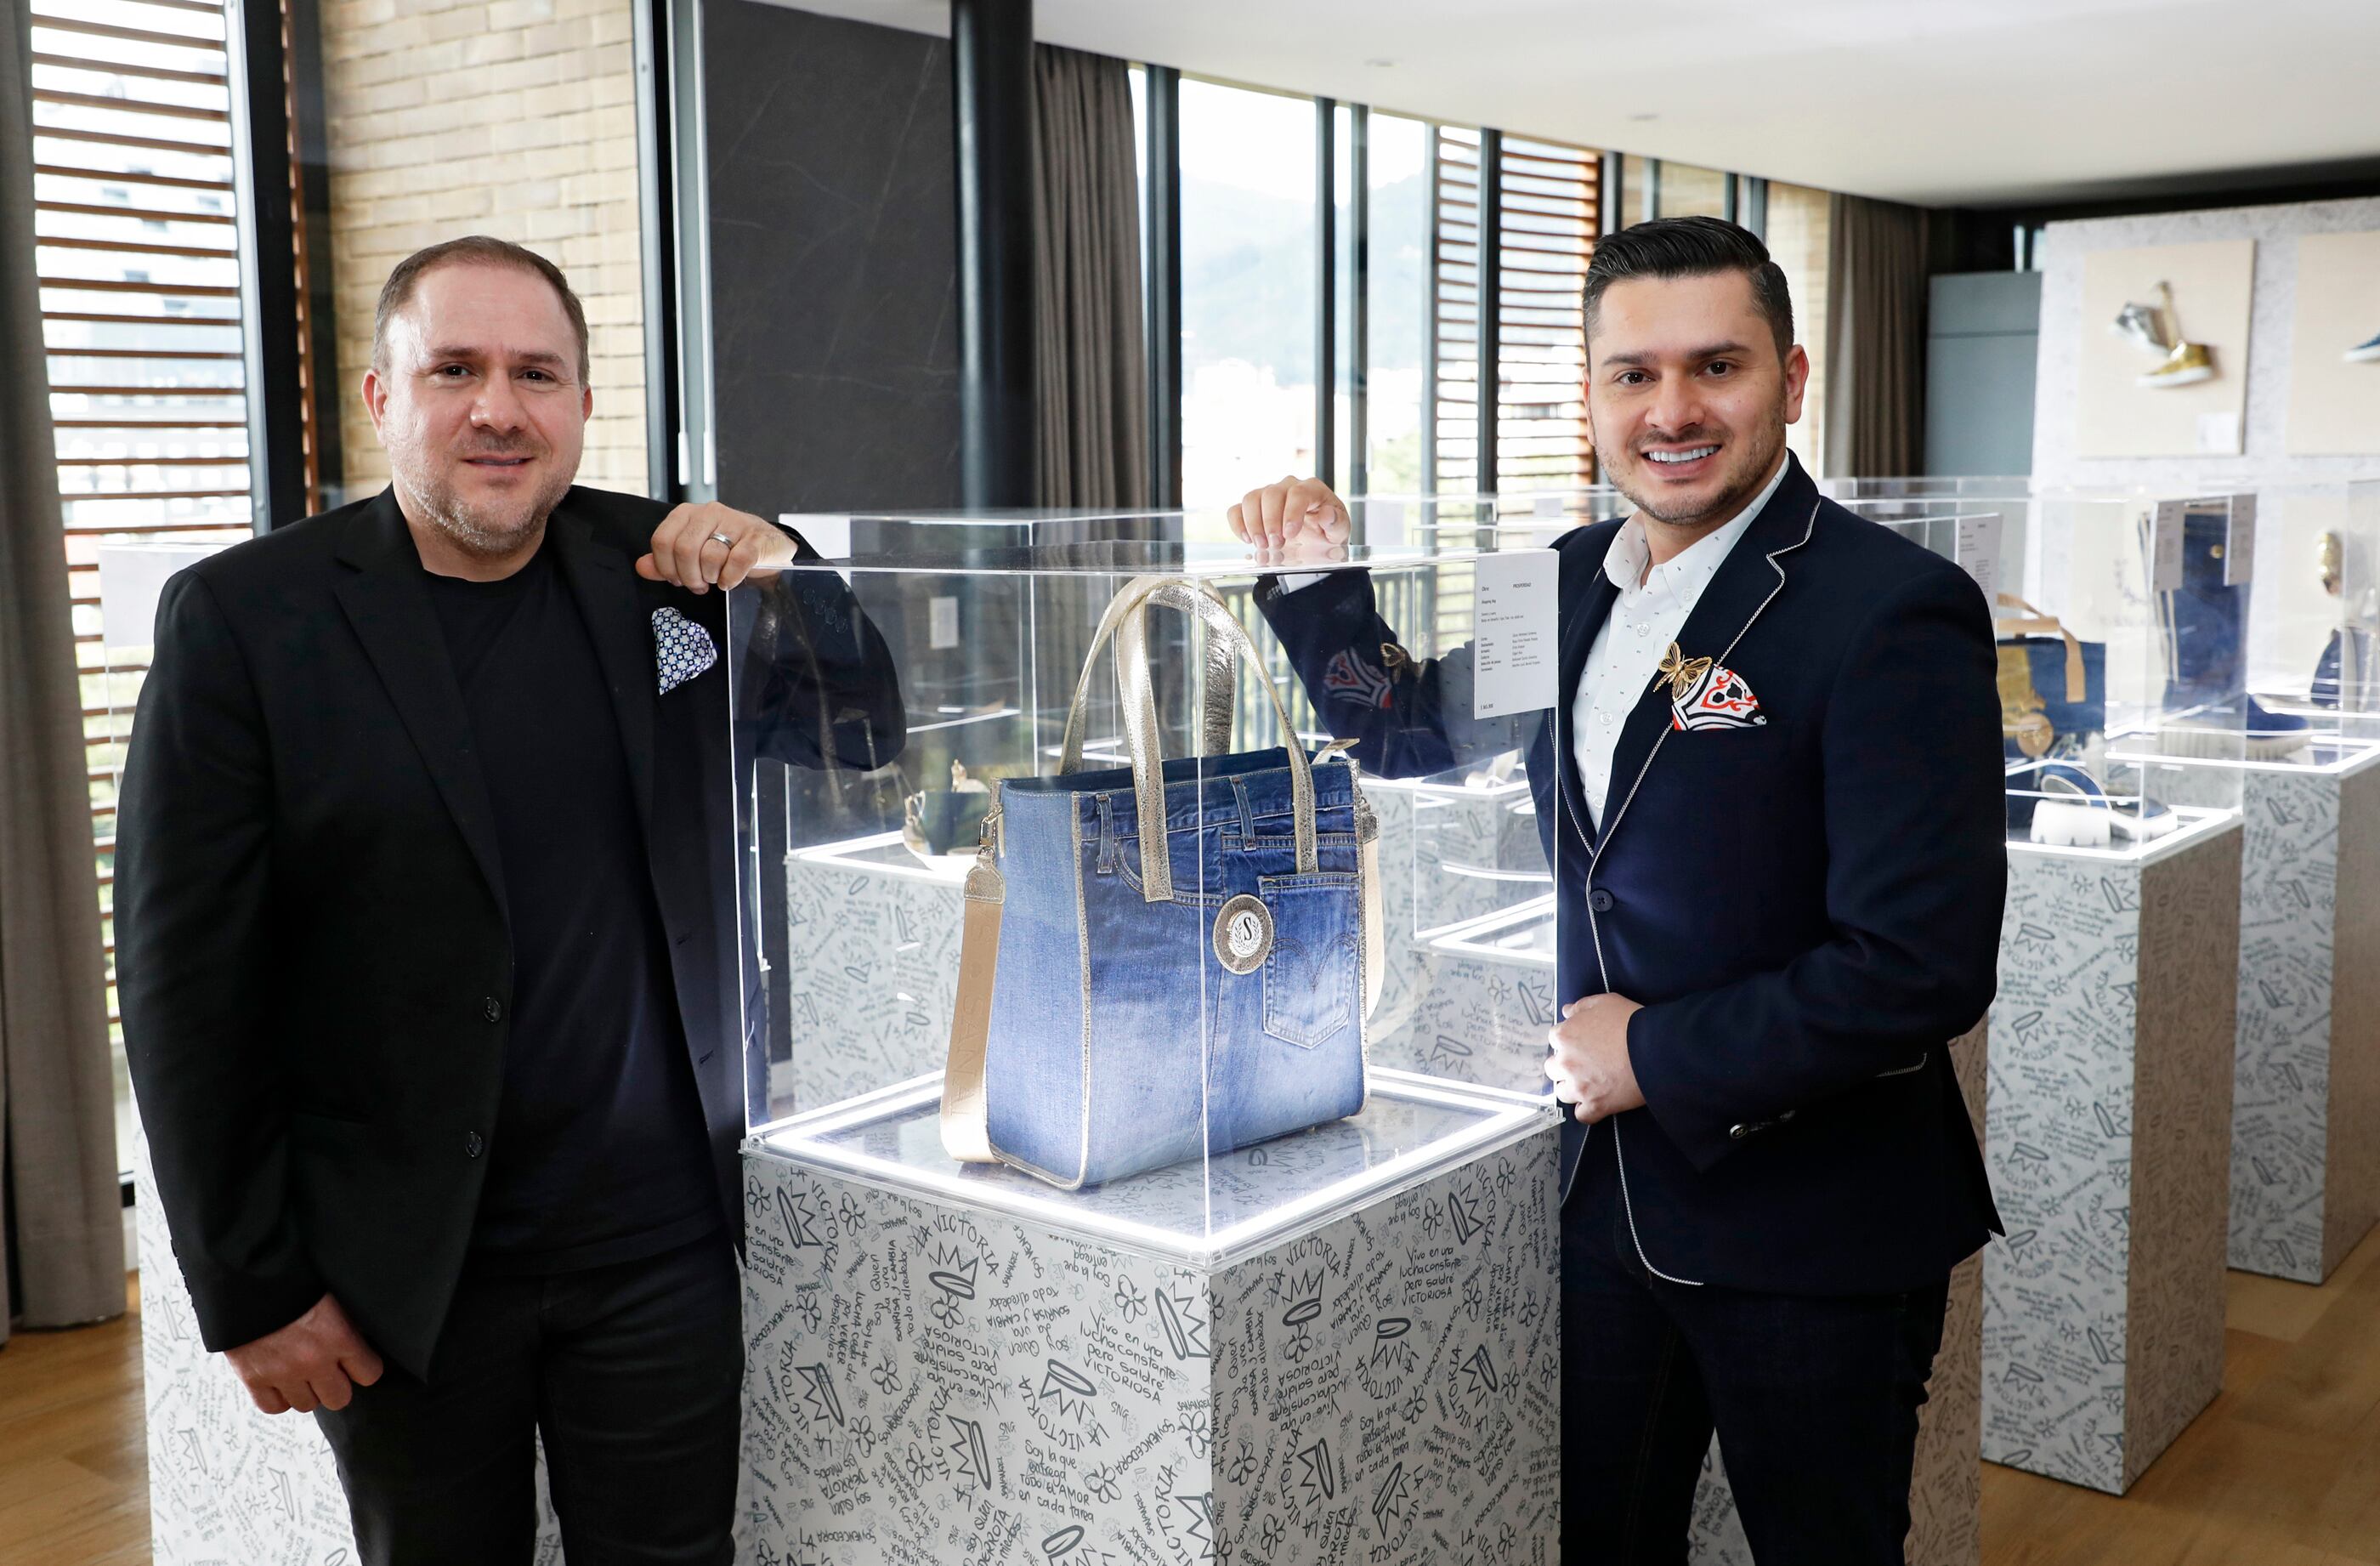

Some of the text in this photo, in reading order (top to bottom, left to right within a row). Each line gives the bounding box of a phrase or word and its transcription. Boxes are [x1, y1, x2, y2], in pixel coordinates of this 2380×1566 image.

[1244, 917, 1252, 940] S
[932, 1212, 1000, 1277] VICTORIA
[1286, 1237, 1341, 1279] VICTORIA
[1087, 1342, 1114, 1361] pero
[1089, 1306, 1164, 1359] Vivo en una
[780, 1340, 809, 1433] VICTORIA
[1083, 1355, 1161, 1404] VICTORIOSA
[927, 1385, 952, 1481] VICTORIA
[1018, 1375, 1085, 1452] VICTORIA
